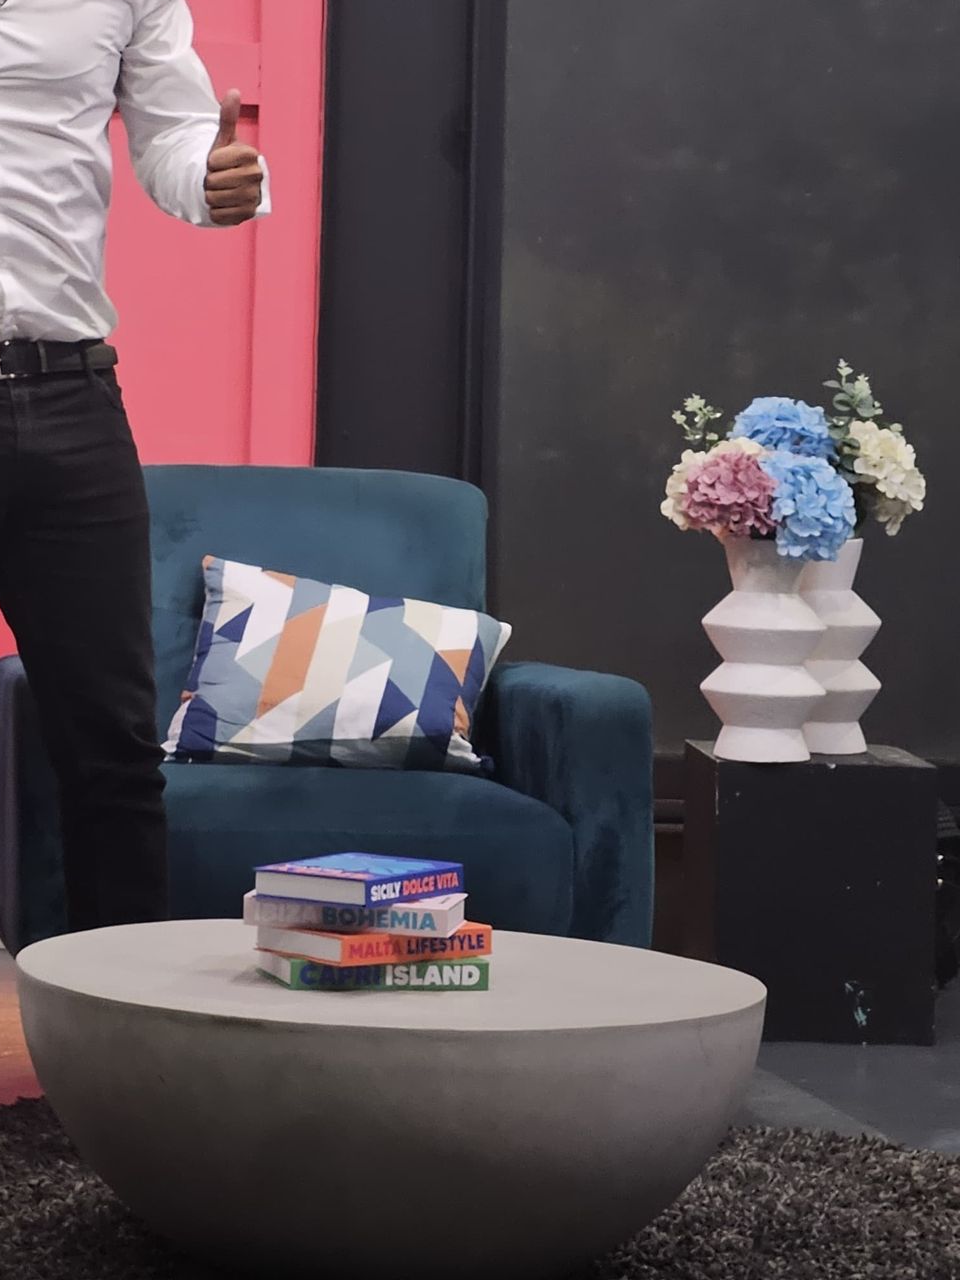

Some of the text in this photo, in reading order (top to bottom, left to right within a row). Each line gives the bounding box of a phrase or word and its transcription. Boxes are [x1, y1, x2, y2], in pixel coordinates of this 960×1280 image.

[370, 871, 459, 903] SICILY DOLCE VITA
[321, 906, 437, 931] BOHEMIA
[348, 933, 486, 960] MALTA LIFESTYLE
[298, 963, 481, 987] CAPRI ISLAND
